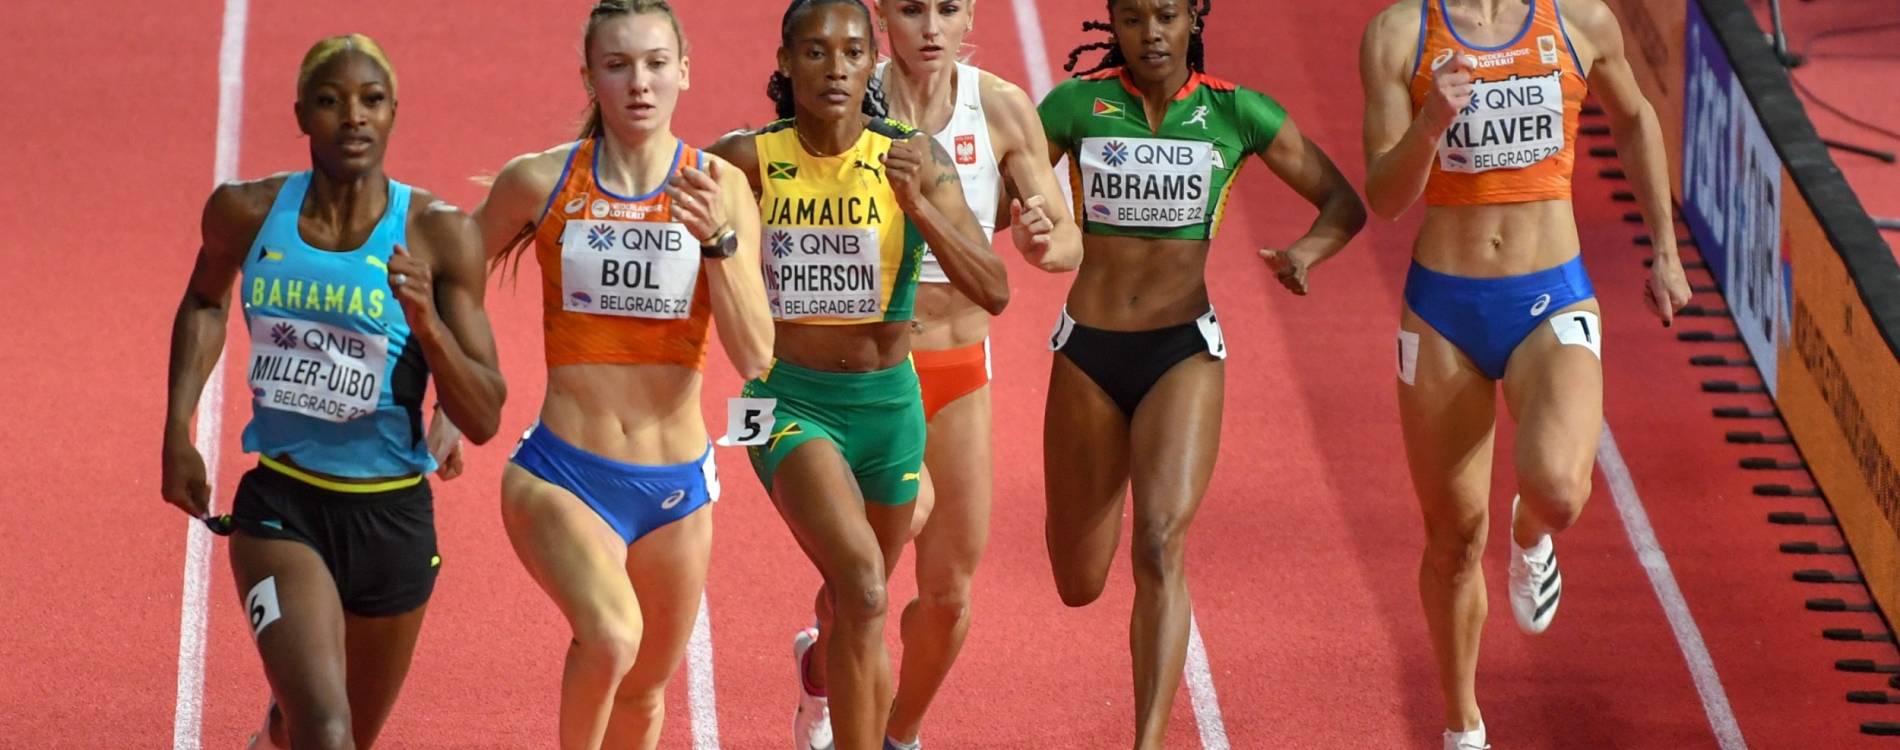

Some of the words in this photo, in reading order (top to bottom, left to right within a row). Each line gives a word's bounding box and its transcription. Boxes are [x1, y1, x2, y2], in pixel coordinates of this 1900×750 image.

[1485, 86, 1545, 110] QNB
[1446, 114, 1553, 148] KLAVER
[1134, 144, 1194, 165] QNB
[1474, 148, 1540, 169] BELGRADE
[1090, 172, 1203, 201] ABRAMS
[767, 196, 882, 225] JAMAICA
[1118, 207, 1185, 222] BELGRADE
[1186, 207, 1202, 220] 22
[621, 228, 682, 252] QNB
[800, 233, 861, 255] QNB
[601, 258, 660, 290] BOL
[252, 276, 385, 319] BAHAMAS
[600, 294, 670, 313] BELGRADE
[672, 299, 688, 313] 22
[784, 300, 855, 315] BELGRADE
[858, 298, 876, 313] 22
[303, 329, 366, 359] QNB
[251, 355, 376, 401] MILLER-UIBO
[273, 389, 346, 419] BELGRADE
[737, 409, 762, 442] 5
[249, 593, 266, 631] 6
